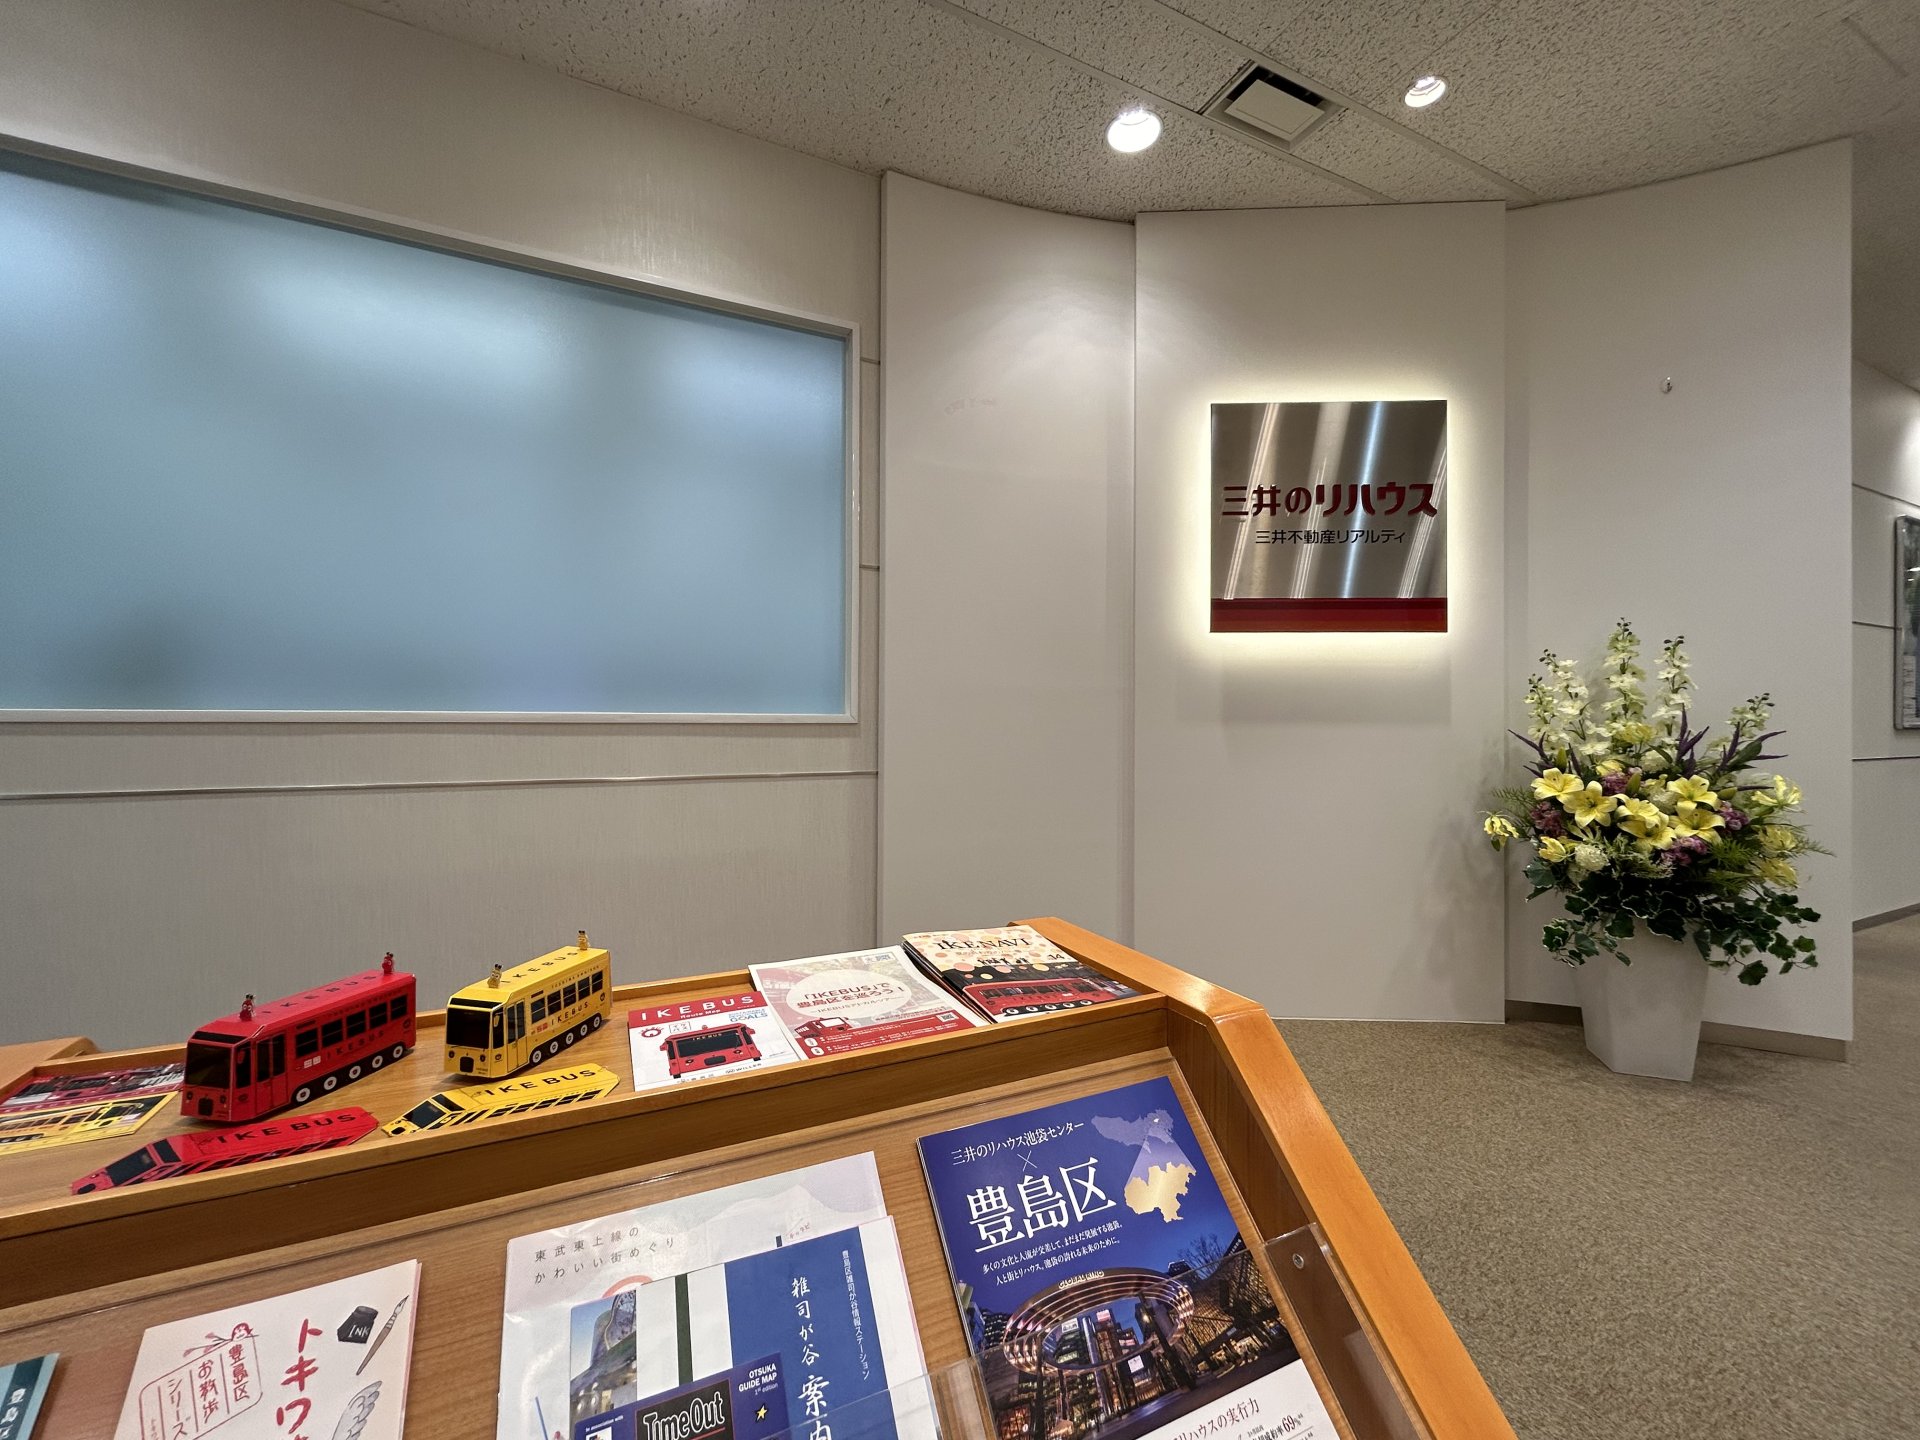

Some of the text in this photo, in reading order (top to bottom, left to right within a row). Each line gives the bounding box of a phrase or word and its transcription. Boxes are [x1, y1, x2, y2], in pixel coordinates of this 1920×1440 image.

[1222, 482, 1438, 517] 三井のリハウス
[1255, 529, 1406, 544] 三井不動産リアルティ
[932, 938, 1032, 950] IKENAVI
[500, 951, 578, 984] IKEBUS
[262, 975, 377, 1014] IKEBUS
[640, 995, 754, 1021] IKEBUS
[551, 1001, 588, 1026] IKEBUS
[730, 1013, 768, 1023] GOALS
[484, 1069, 596, 1096] IKEBUS
[218, 1112, 356, 1144] IKEBUS
[951, 1122, 1084, 1166] 三井のリハウス池袋センター
[966, 1156, 1117, 1253] 豊島区
[534, 1226, 640, 1262] 東武東上線の
[534, 1238, 674, 1285] かわいい街めぐり
[348, 1324, 370, 1338] INK
[841, 1250, 870, 1381] 豊島区雑司が谷情報ステーション
[228, 1344, 250, 1402] 豊島区
[276, 1318, 323, 1440] トキワ
[738, 1372, 778, 1393] GUIDE MAP
[749, 1363, 777, 1379] OTSUKA
[762, 1383, 779, 1393] edition
[198, 1359, 219, 1424] お散歩
[168, 1379, 191, 1440] シリーズ
[1175, 1398, 1260, 1440] リハウスの実行力
